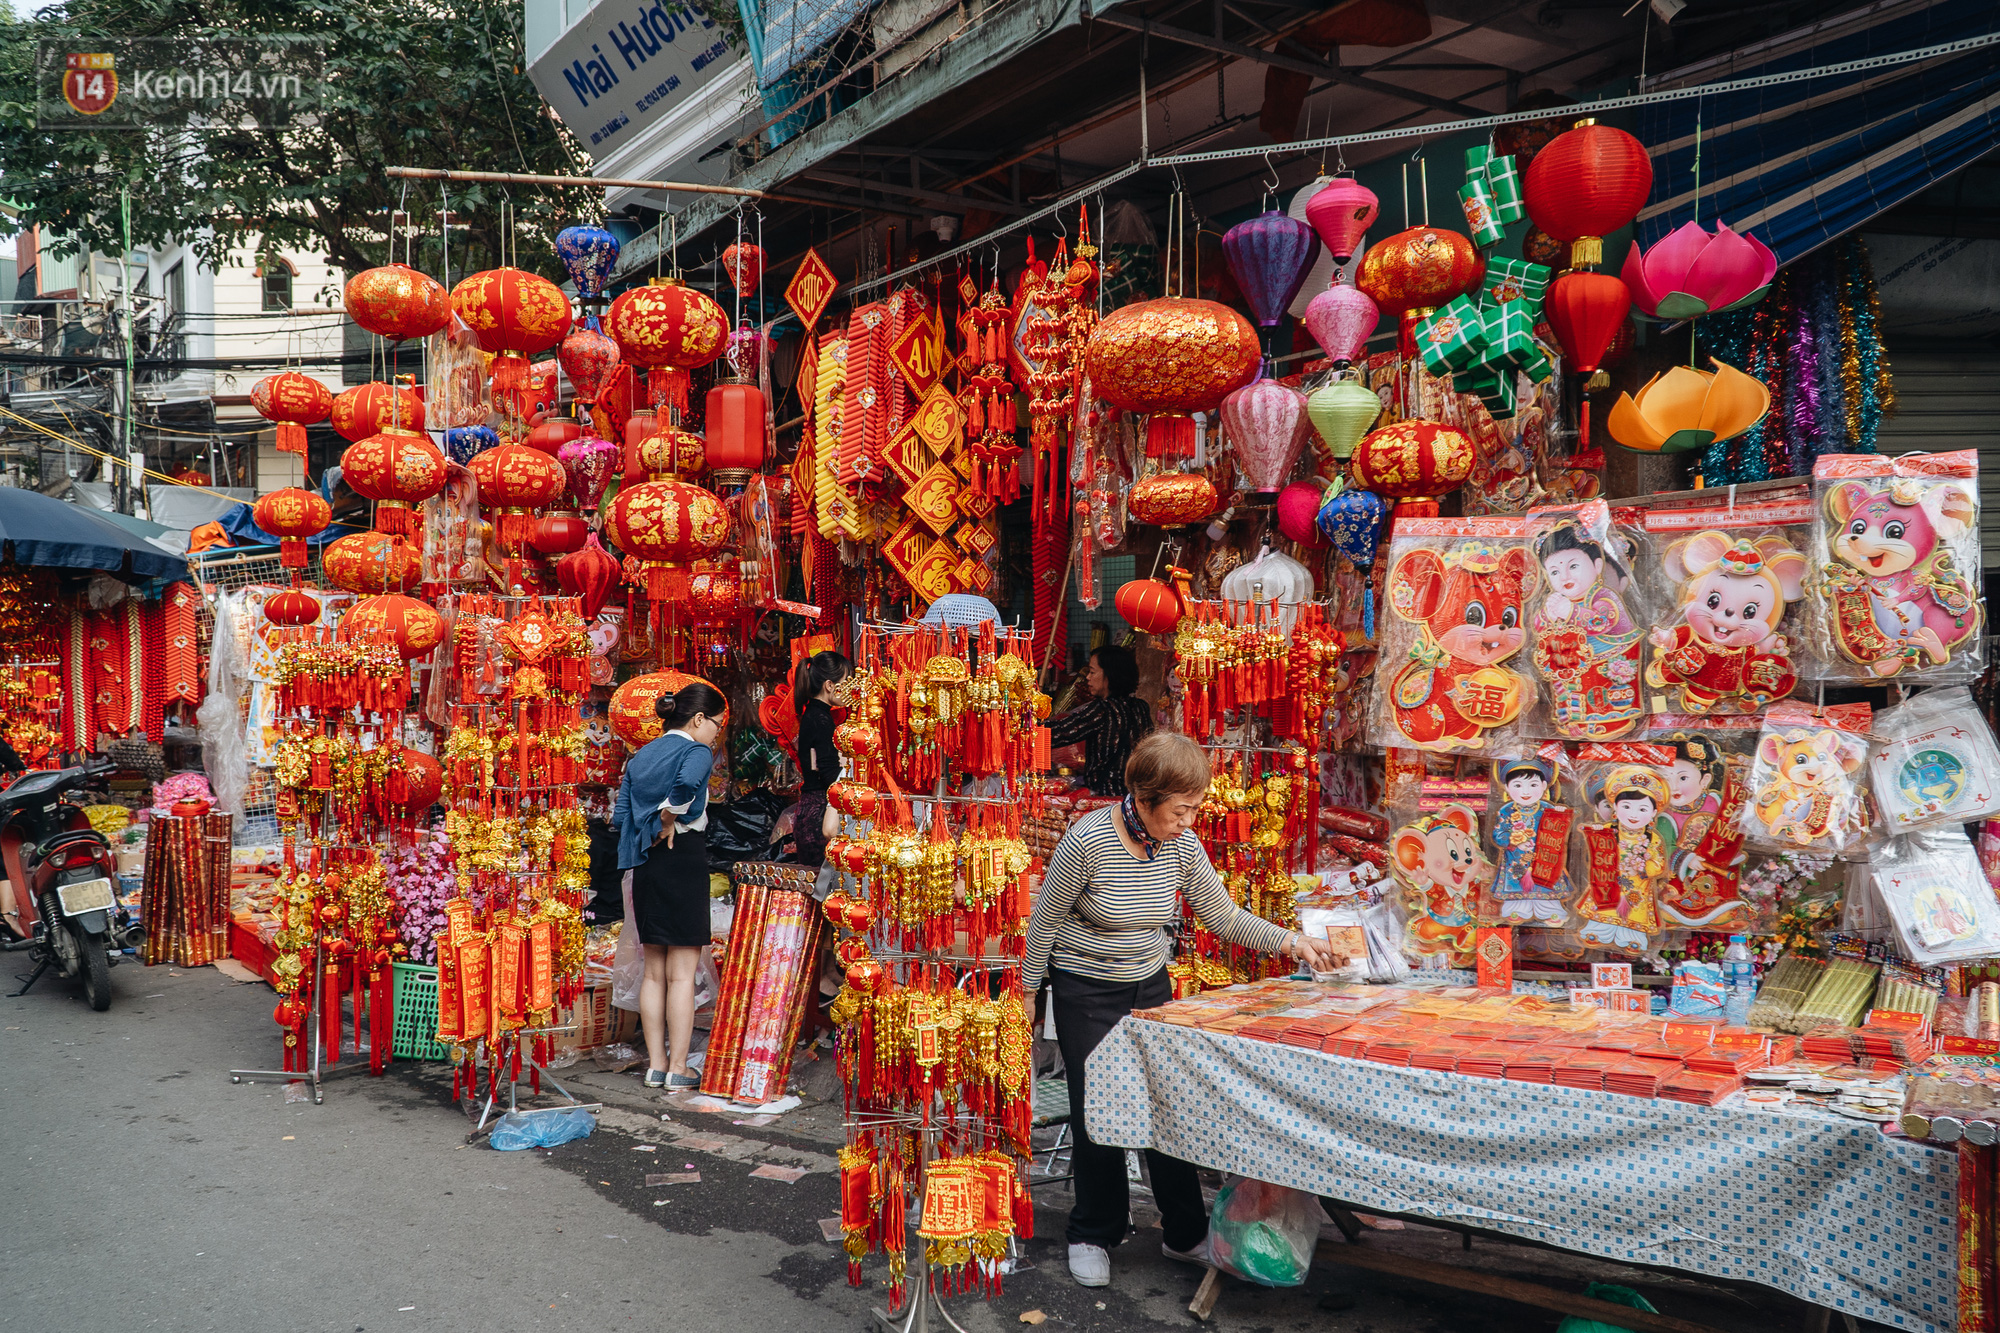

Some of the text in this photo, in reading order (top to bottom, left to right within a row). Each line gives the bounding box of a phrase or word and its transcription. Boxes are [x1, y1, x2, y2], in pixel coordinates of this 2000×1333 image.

[562, 44, 620, 107] Mai
[1880, 251, 1928, 286] COMPOSITE
[1923, 258, 1938, 273] ISO
[797, 263, 823, 314] CHÚC
[924, 400, 954, 439] 福
[920, 480, 956, 518] 福
[921, 558, 955, 597] 福
[631, 687, 659, 699] Mừng
[1459, 682, 1509, 719] 福
[1542, 817, 1566, 833] Chúc
[1710, 820, 1740, 842] Như
[1539, 831, 1563, 850] Mừng
[1708, 839, 1725, 857] Ý
[1537, 847, 1559, 864] Năm
[1533, 863, 1553, 880] Mới
[466, 962, 486, 975] VẠN
[470, 974, 483, 985] SỰ
[467, 984, 488, 997] NHƯ
[475, 997, 482, 1007] Ý
[595, 996, 606, 1017] HOA
